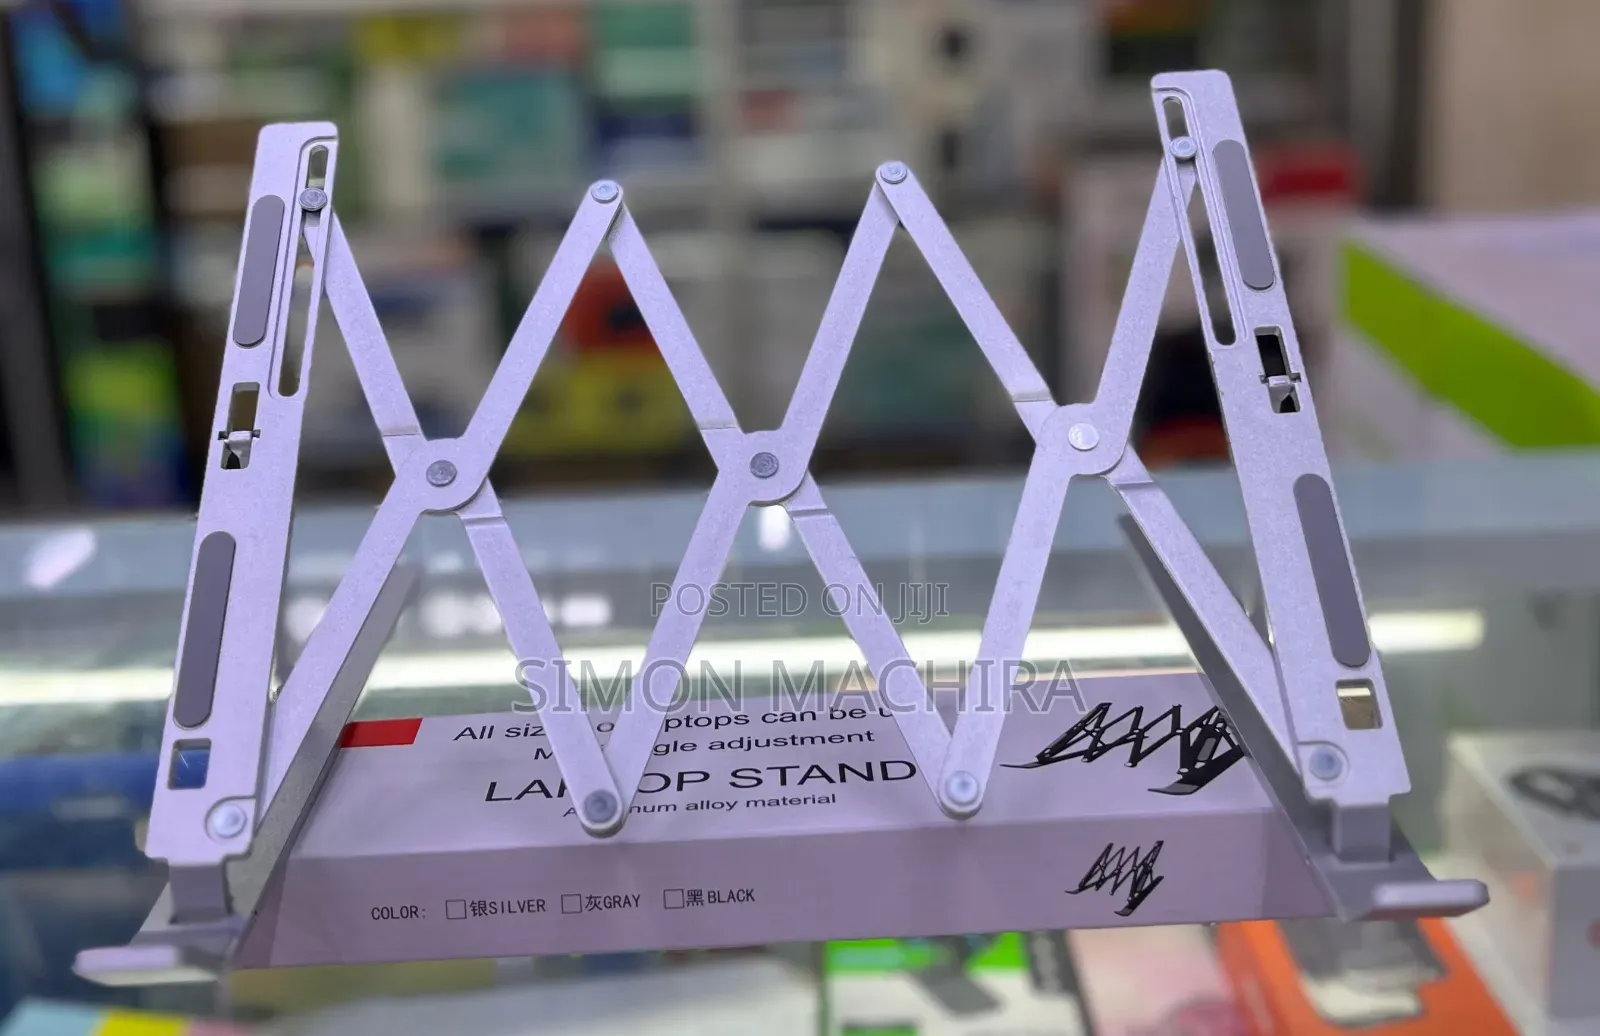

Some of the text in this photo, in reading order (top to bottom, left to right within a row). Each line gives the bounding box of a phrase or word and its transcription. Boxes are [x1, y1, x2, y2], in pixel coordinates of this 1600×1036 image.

[453, 725, 495, 741] All
[504, 724, 547, 738] siz
[664, 712, 750, 732] ptops
[761, 710, 817, 724] can
[829, 706, 867, 720] be
[708, 730, 875, 751] adjustment
[485, 760, 917, 802] LAOP STAND
[685, 800, 738, 813] alloy
[746, 793, 836, 809] material
[371, 905, 426, 920] COLOR:
